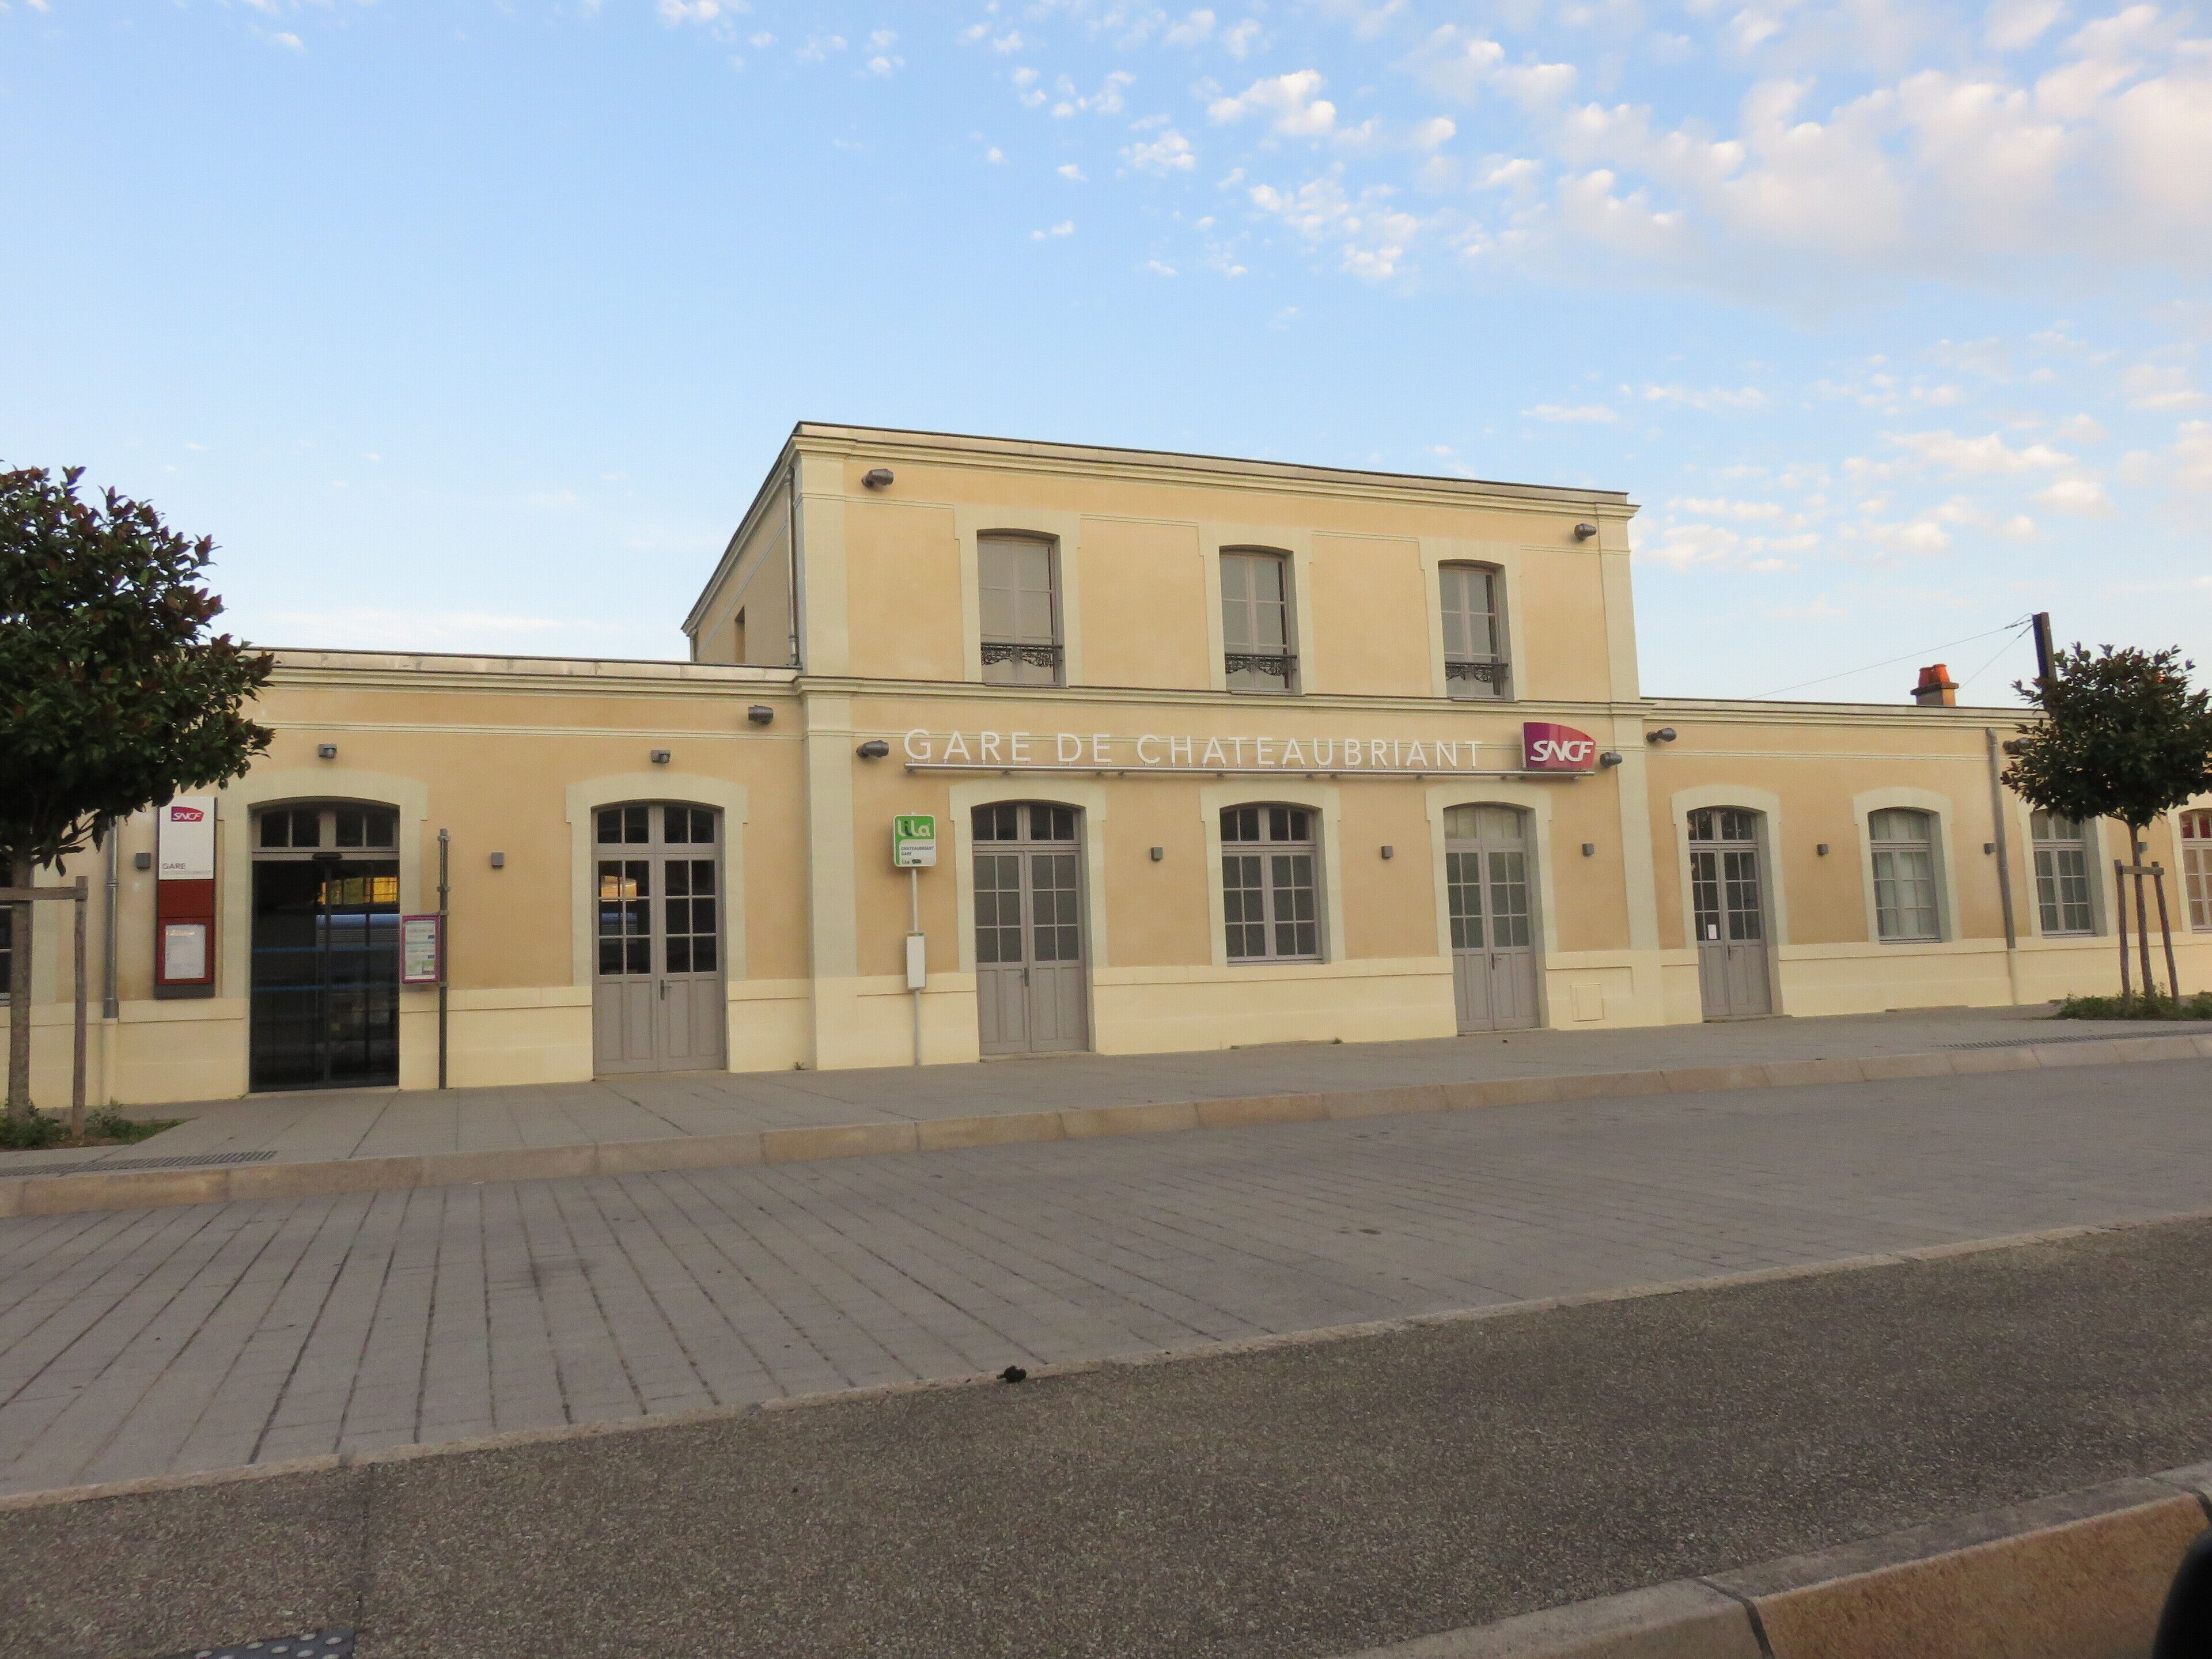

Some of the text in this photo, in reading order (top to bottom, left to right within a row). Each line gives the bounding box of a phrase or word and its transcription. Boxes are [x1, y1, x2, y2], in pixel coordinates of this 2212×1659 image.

[904, 729, 1482, 767] GARE DE CHATEAUBRIANT
[1530, 740, 1594, 762] SNCF
[172, 812, 203, 820] SNCF
[897, 820, 930, 836] lila
